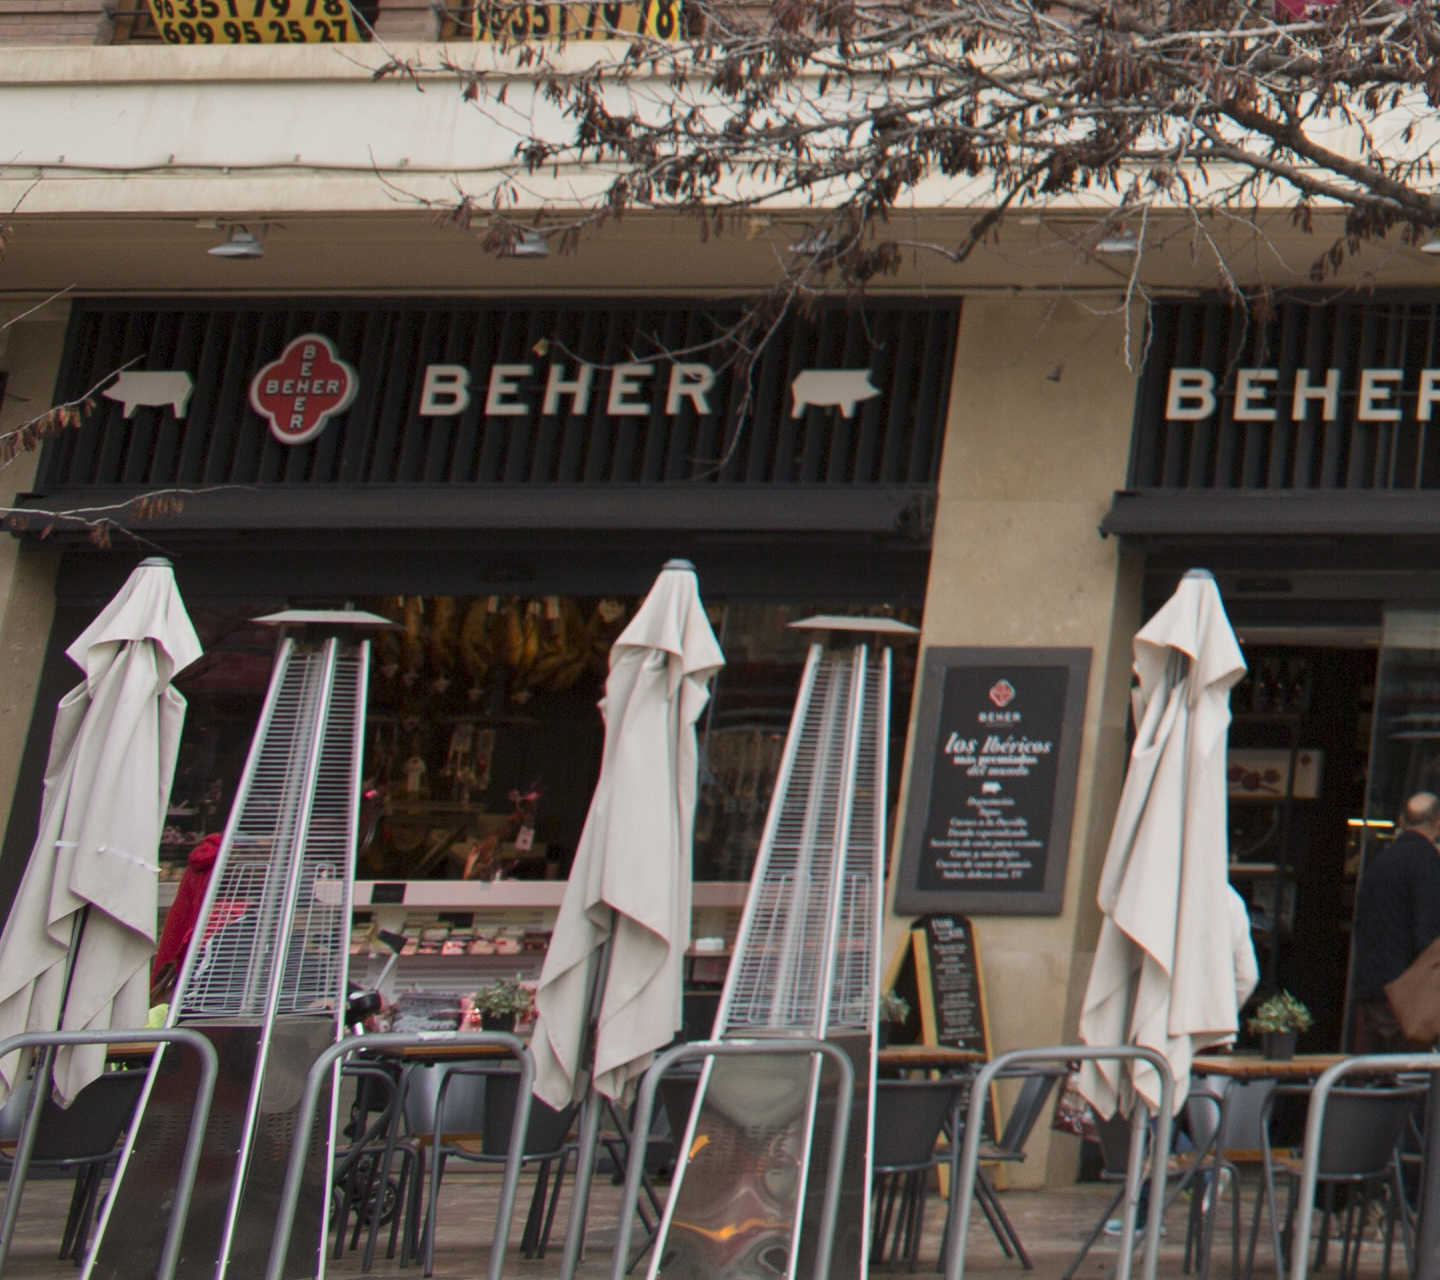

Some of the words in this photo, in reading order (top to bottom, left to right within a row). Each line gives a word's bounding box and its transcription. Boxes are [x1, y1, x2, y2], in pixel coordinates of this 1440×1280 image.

[163, 22, 215, 44] 699
[223, 21, 262, 44] 95
[268, 20, 306, 44] 25
[313, 19, 348, 43] 27
[266, 379, 338, 395] BEHER
[290, 344, 317, 430] BEHER
[419, 363, 715, 416] BEHER
[945, 731, 978, 754] los
[981, 734, 1052, 754] Ibéricos
